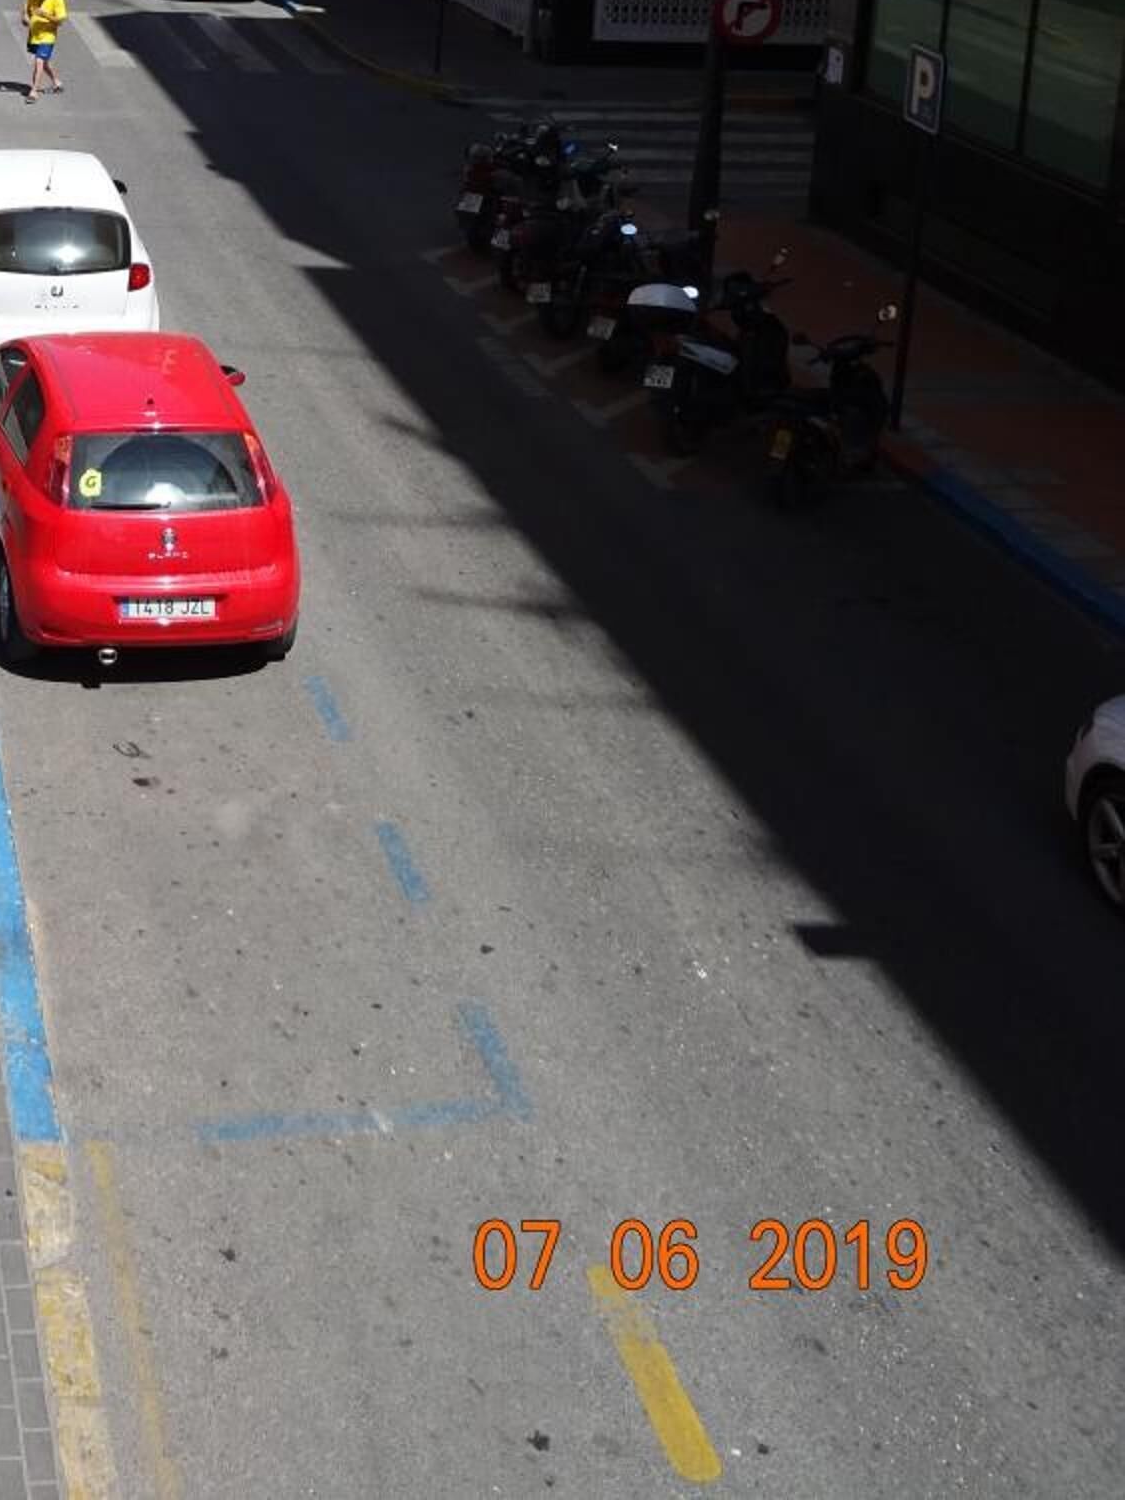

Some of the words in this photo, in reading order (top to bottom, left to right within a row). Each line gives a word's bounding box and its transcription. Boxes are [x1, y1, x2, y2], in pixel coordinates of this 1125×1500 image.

[910, 53, 936, 116] P
[135, 598, 174, 615] 1418
[181, 598, 210, 615] JZL
